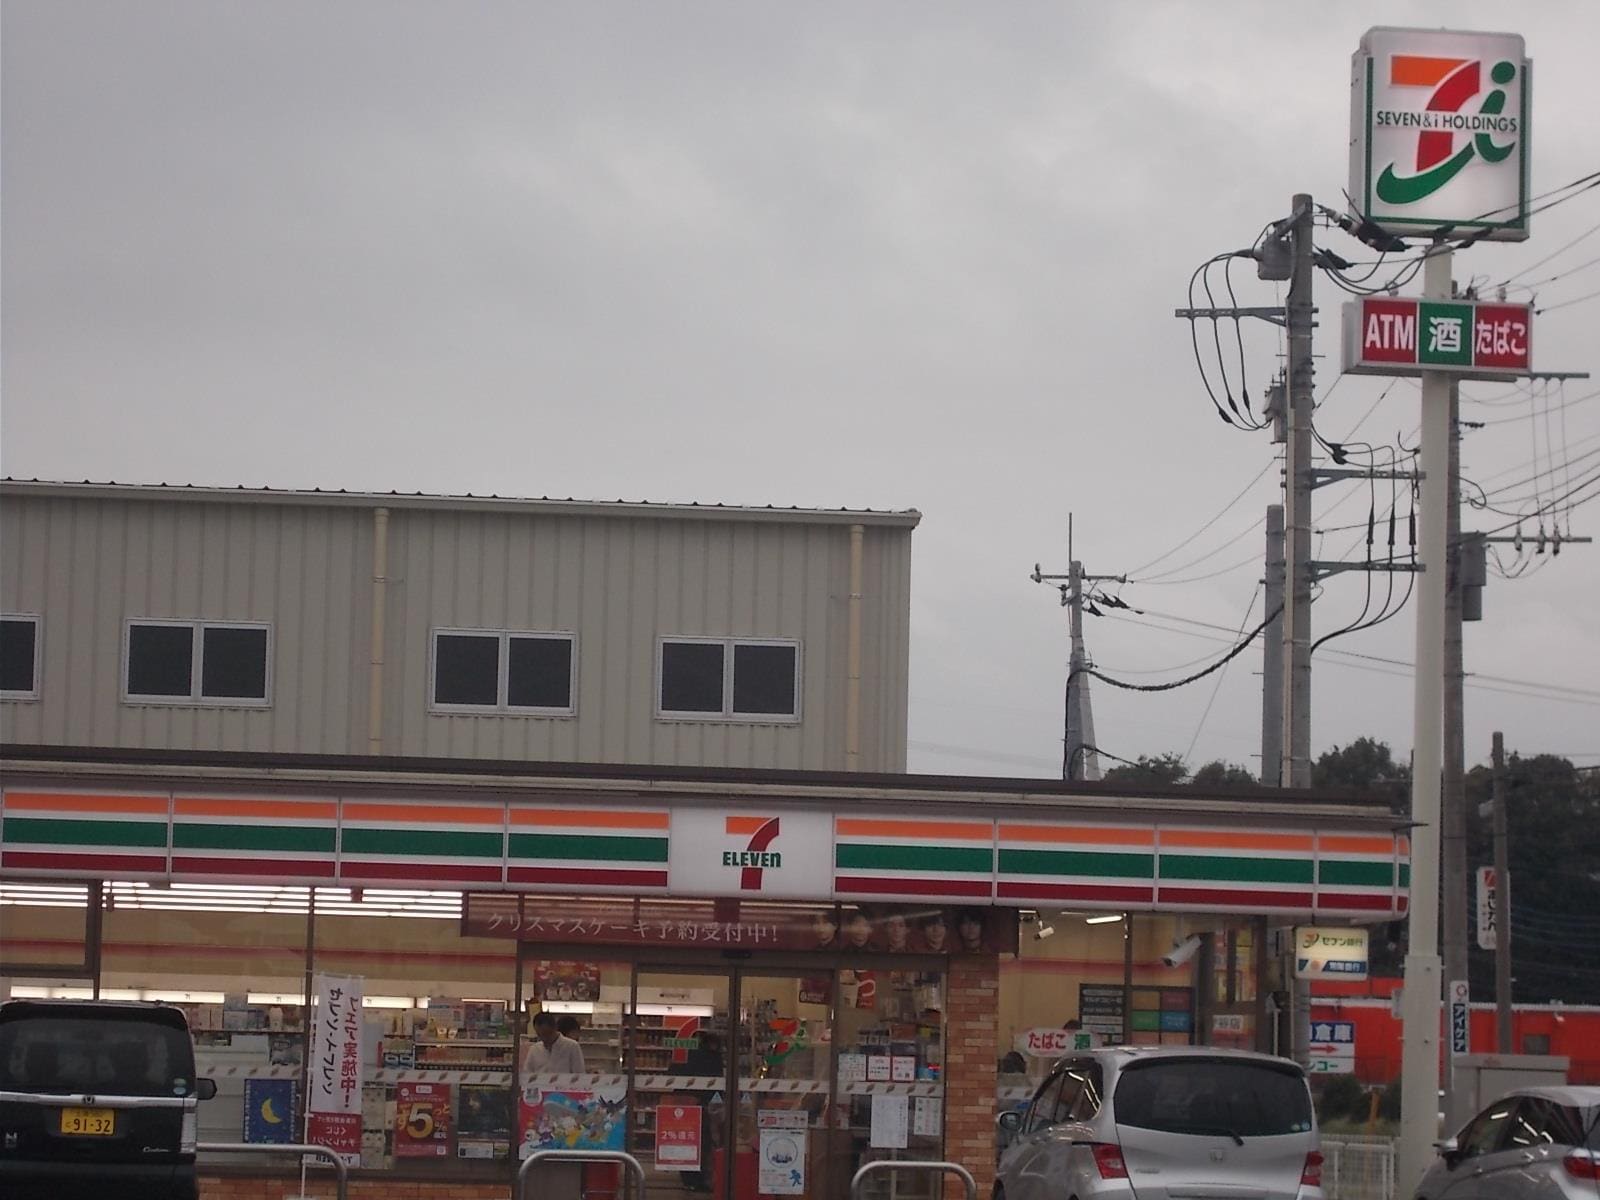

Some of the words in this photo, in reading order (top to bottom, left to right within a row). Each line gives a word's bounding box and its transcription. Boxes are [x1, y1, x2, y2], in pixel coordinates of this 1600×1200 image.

[1442, 114, 1518, 132] HOLDINGS
[1365, 313, 1415, 350] ATM
[1429, 316, 1463, 352] 酒
[1476, 319, 1527, 356] たばこ
[488, 911, 779, 944] クリスマスケーキ予約受付中!
[1028, 1033, 1066, 1049] たばこ
